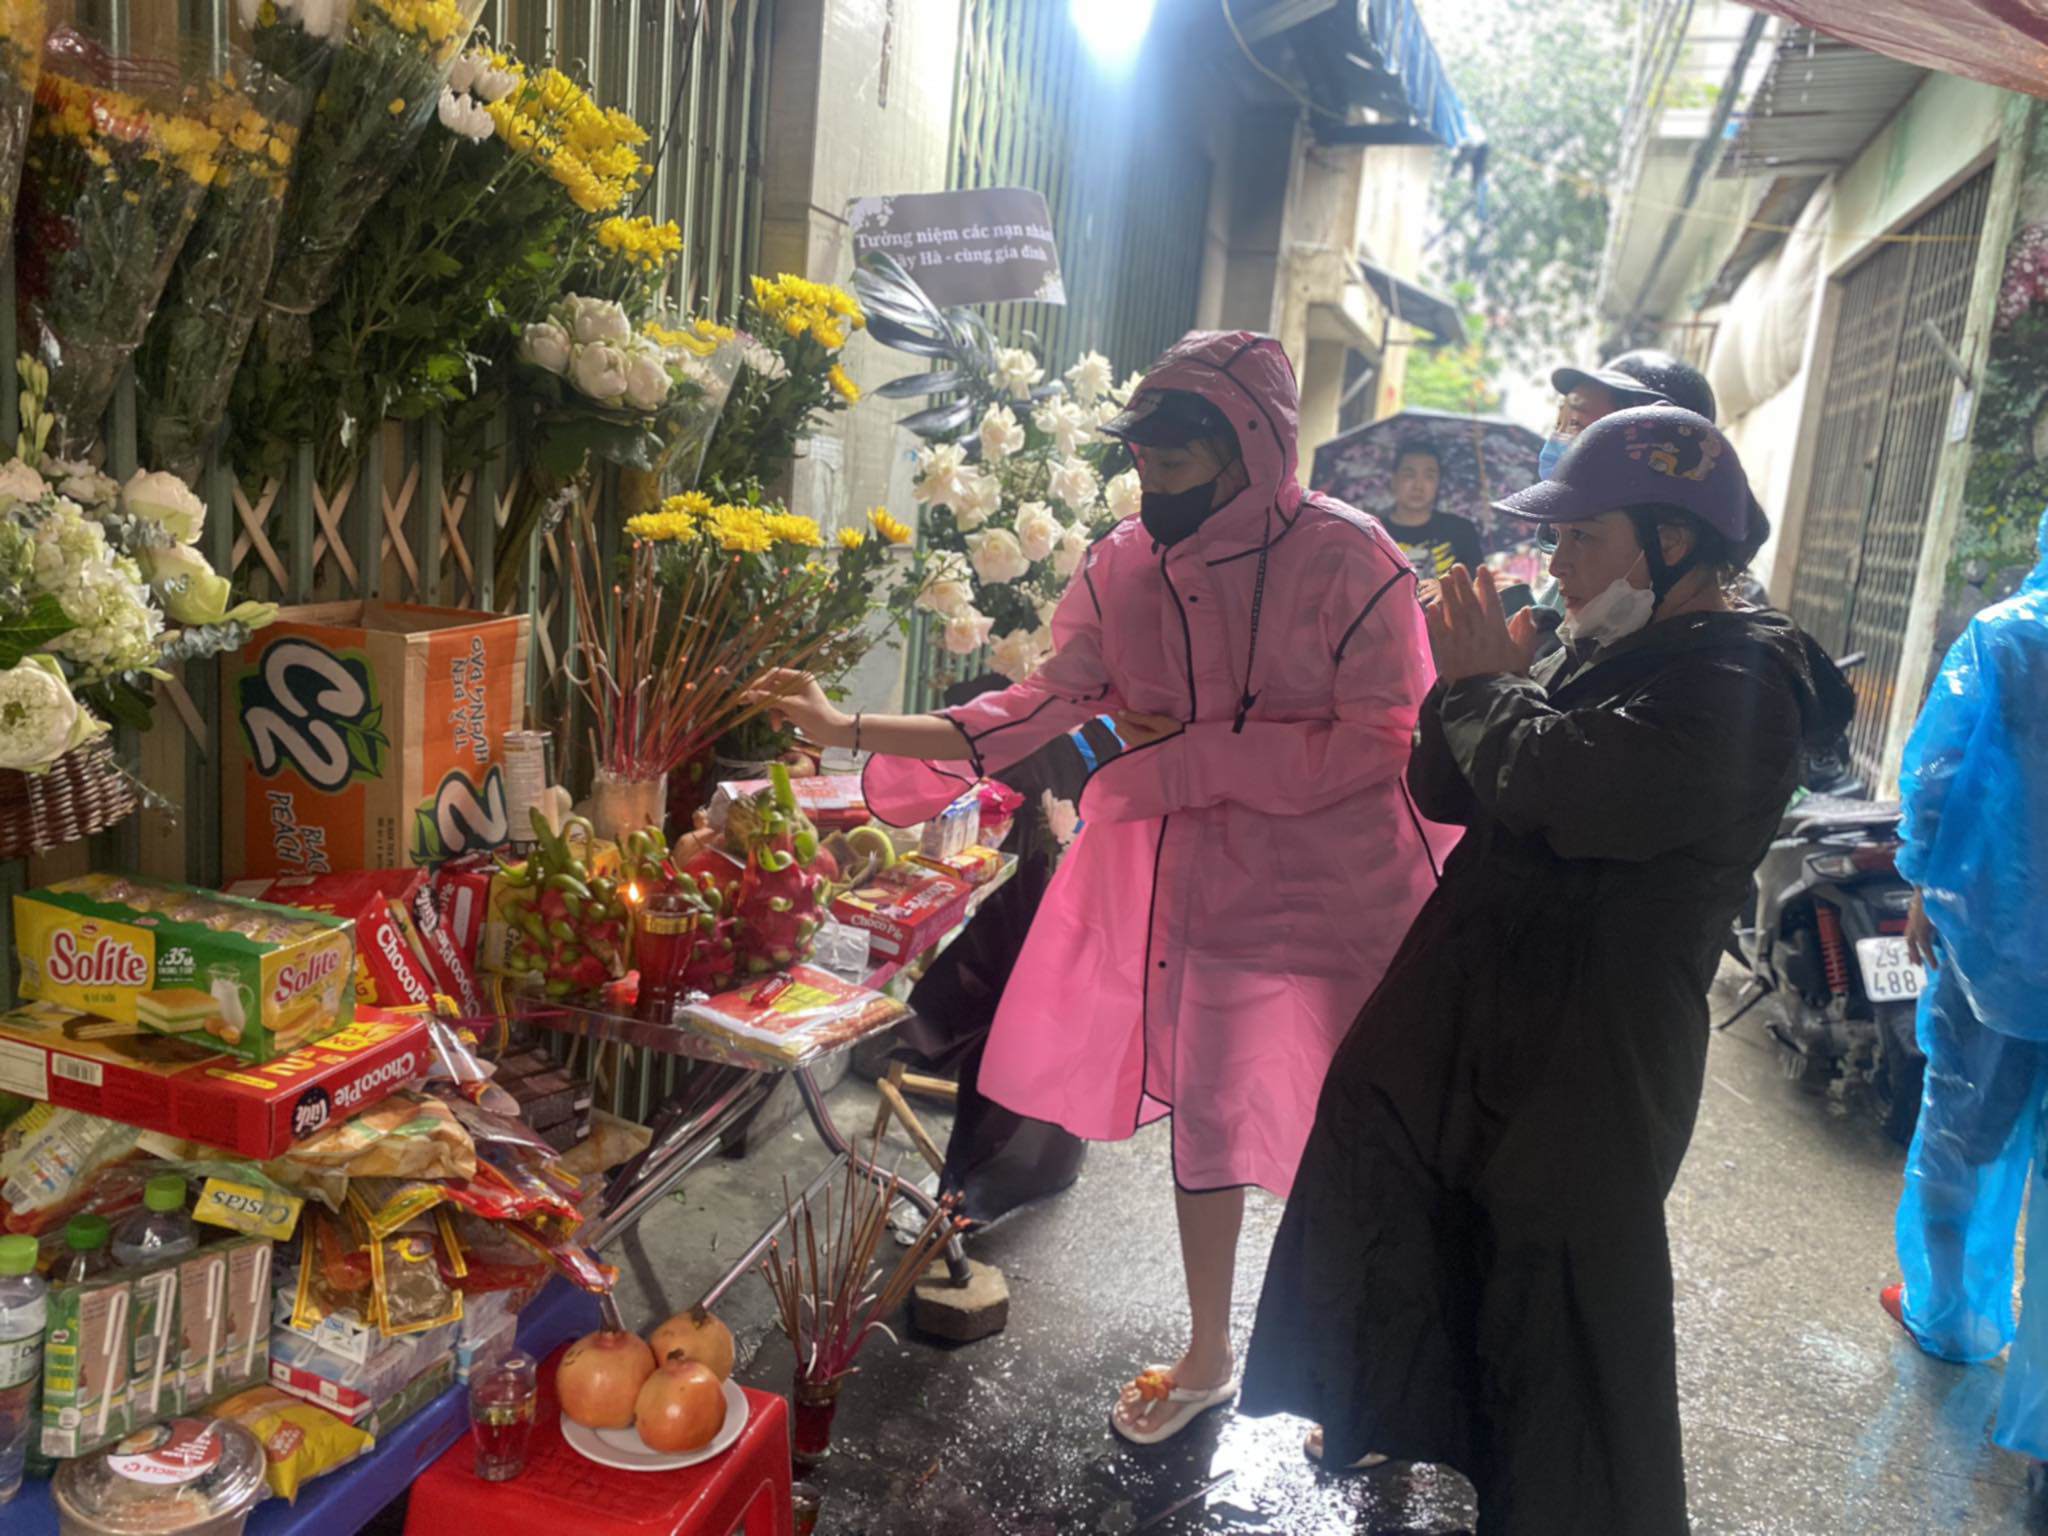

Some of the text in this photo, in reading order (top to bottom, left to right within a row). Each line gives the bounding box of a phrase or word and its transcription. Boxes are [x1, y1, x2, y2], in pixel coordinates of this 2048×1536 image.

[856, 230, 914, 249] Tưởng
[916, 227, 959, 246] niệm
[962, 223, 990, 240] các
[993, 225, 1024, 240] nạn
[954, 248, 993, 264] cùng
[995, 245, 1018, 264] gia
[468, 635, 485, 682] ĐÀO
[242, 636, 367, 789] C2
[448, 658, 469, 754] TRÀ ĐEN
[265, 789, 304, 864] PEACH
[436, 774, 507, 852] 2
[300, 825, 332, 876] BLAC
[48, 930, 147, 984] Solite
[273, 949, 341, 1003] Solite
[376, 923, 430, 1005] ChocoPi
[1874, 969, 1918, 996] 488
[333, 1050, 416, 1107] ChocoPie
[212, 1190, 290, 1225] Custas
